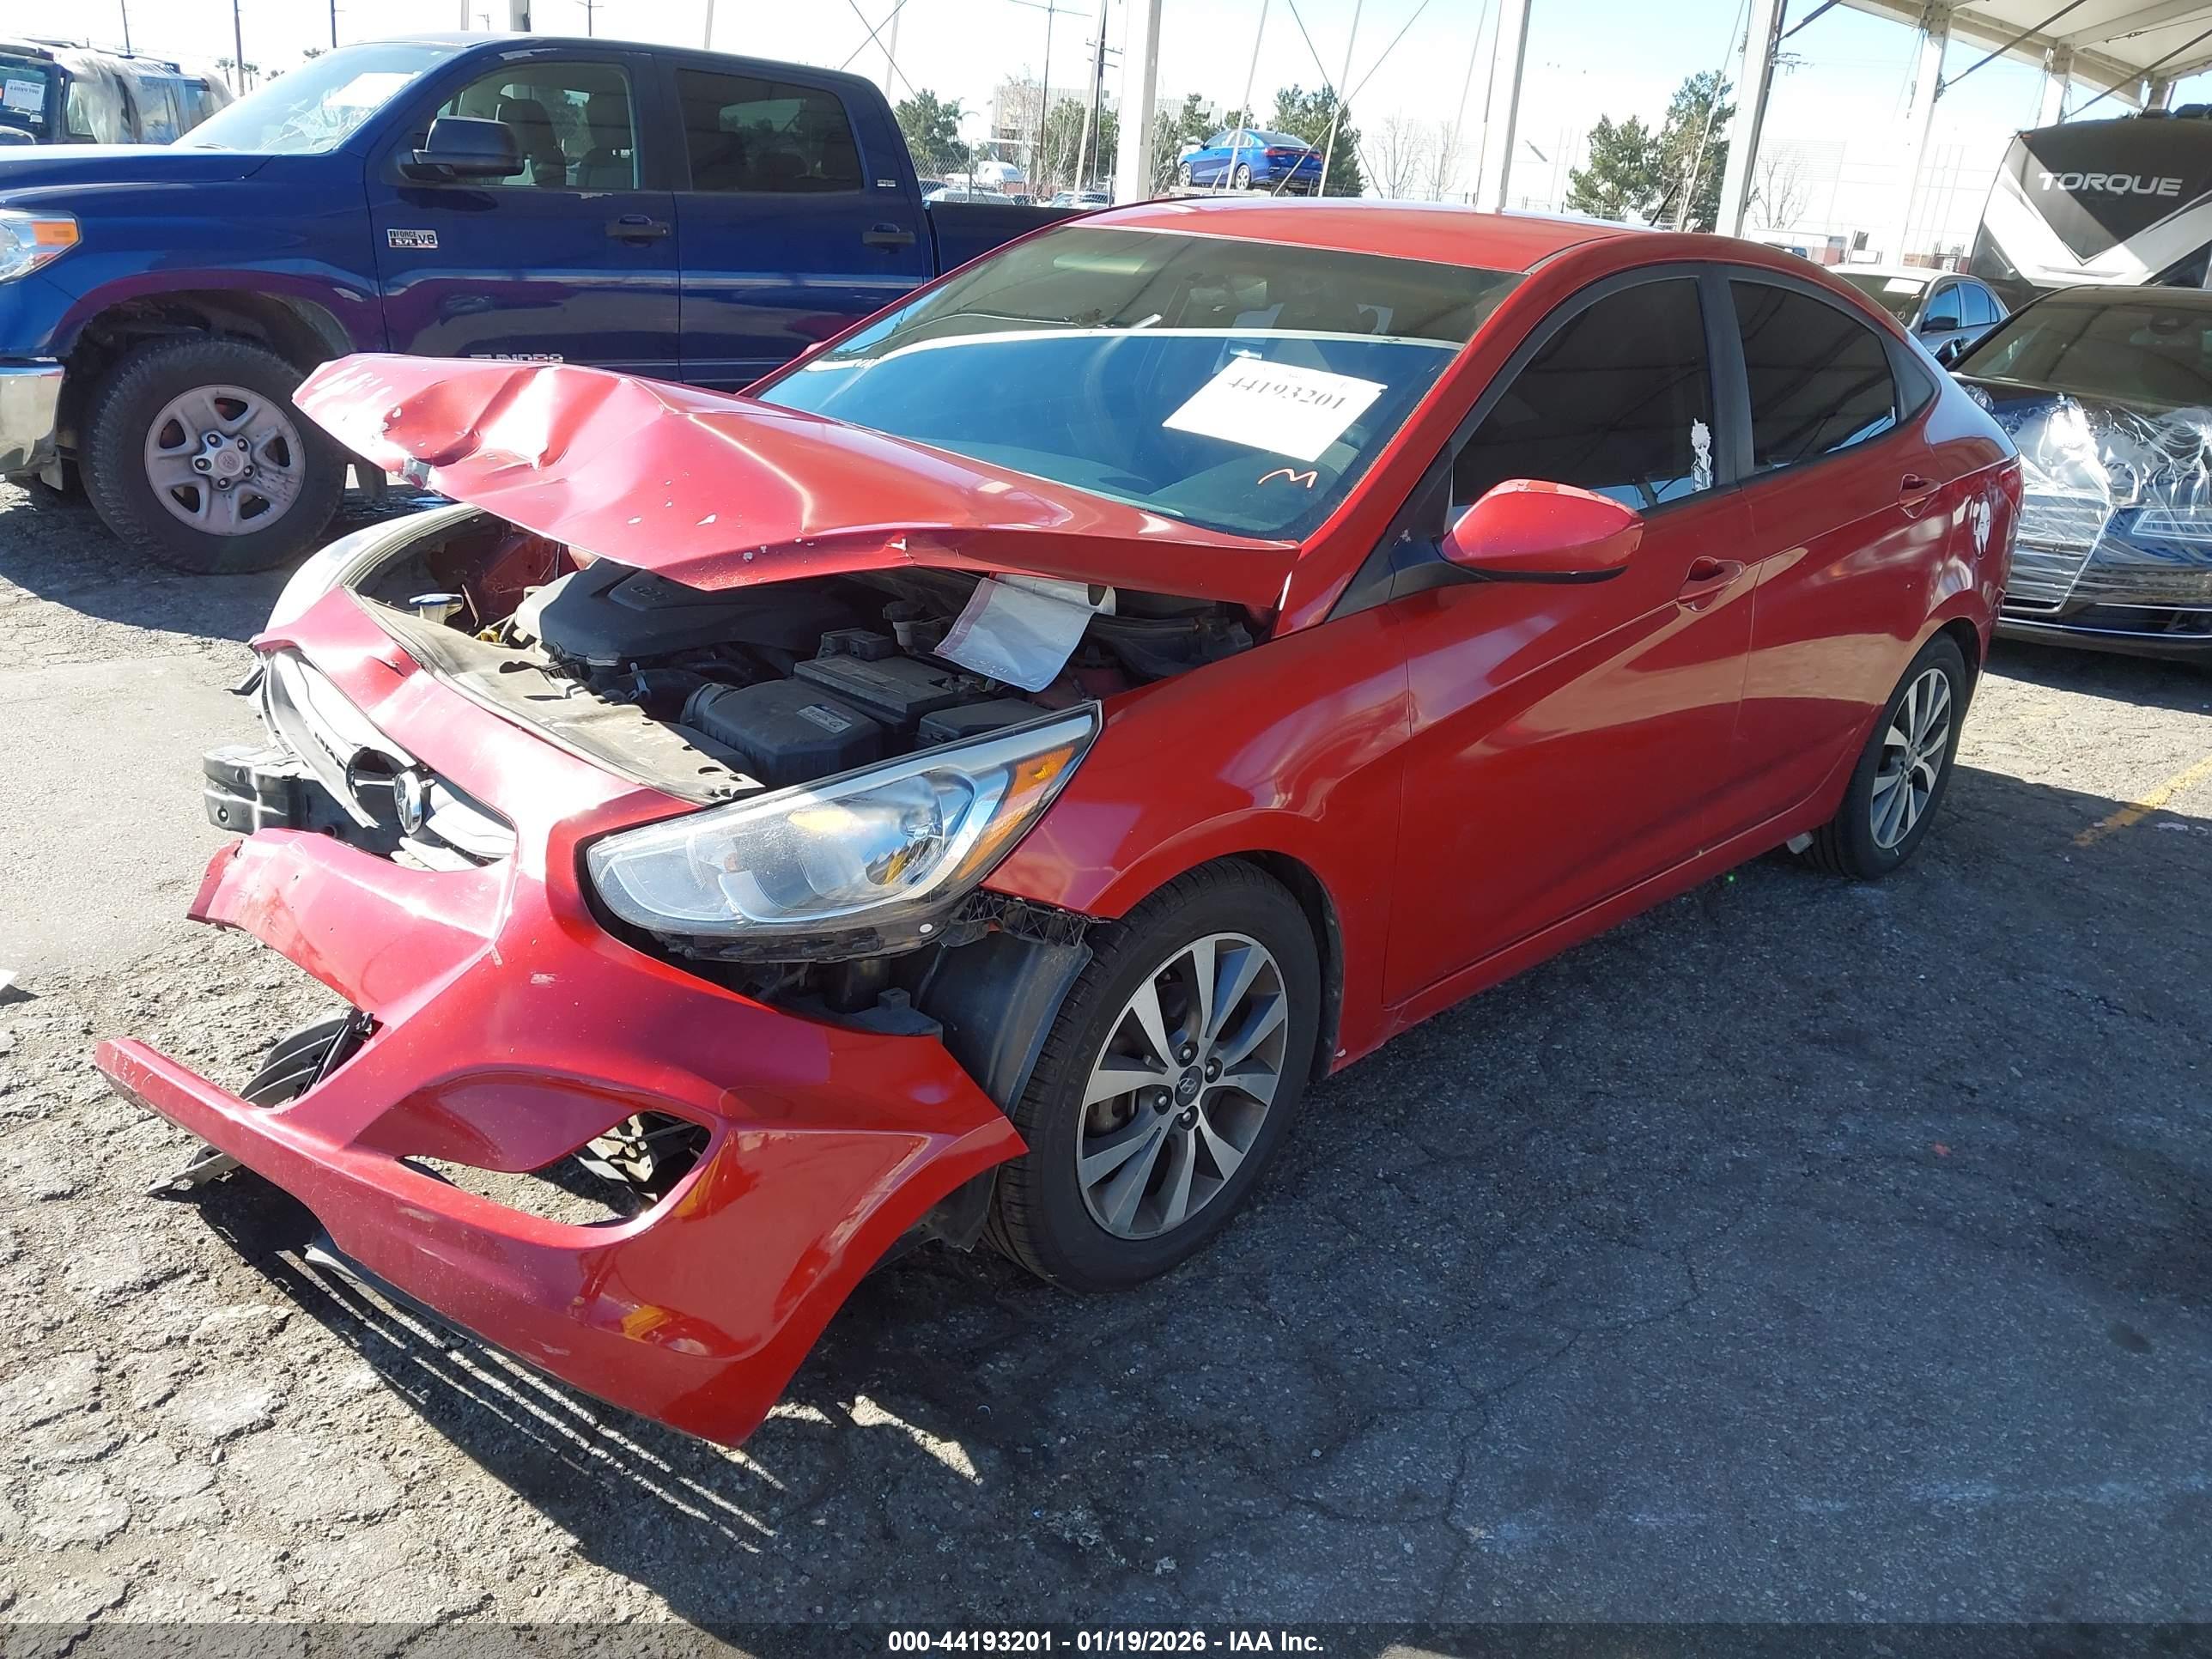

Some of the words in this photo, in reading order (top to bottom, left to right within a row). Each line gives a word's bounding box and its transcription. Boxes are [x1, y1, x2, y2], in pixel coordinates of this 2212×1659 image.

[2039, 172, 2184, 197] TORQUE
[417, 234, 435, 245] V8
[1227, 376, 1347, 410] 44193201
